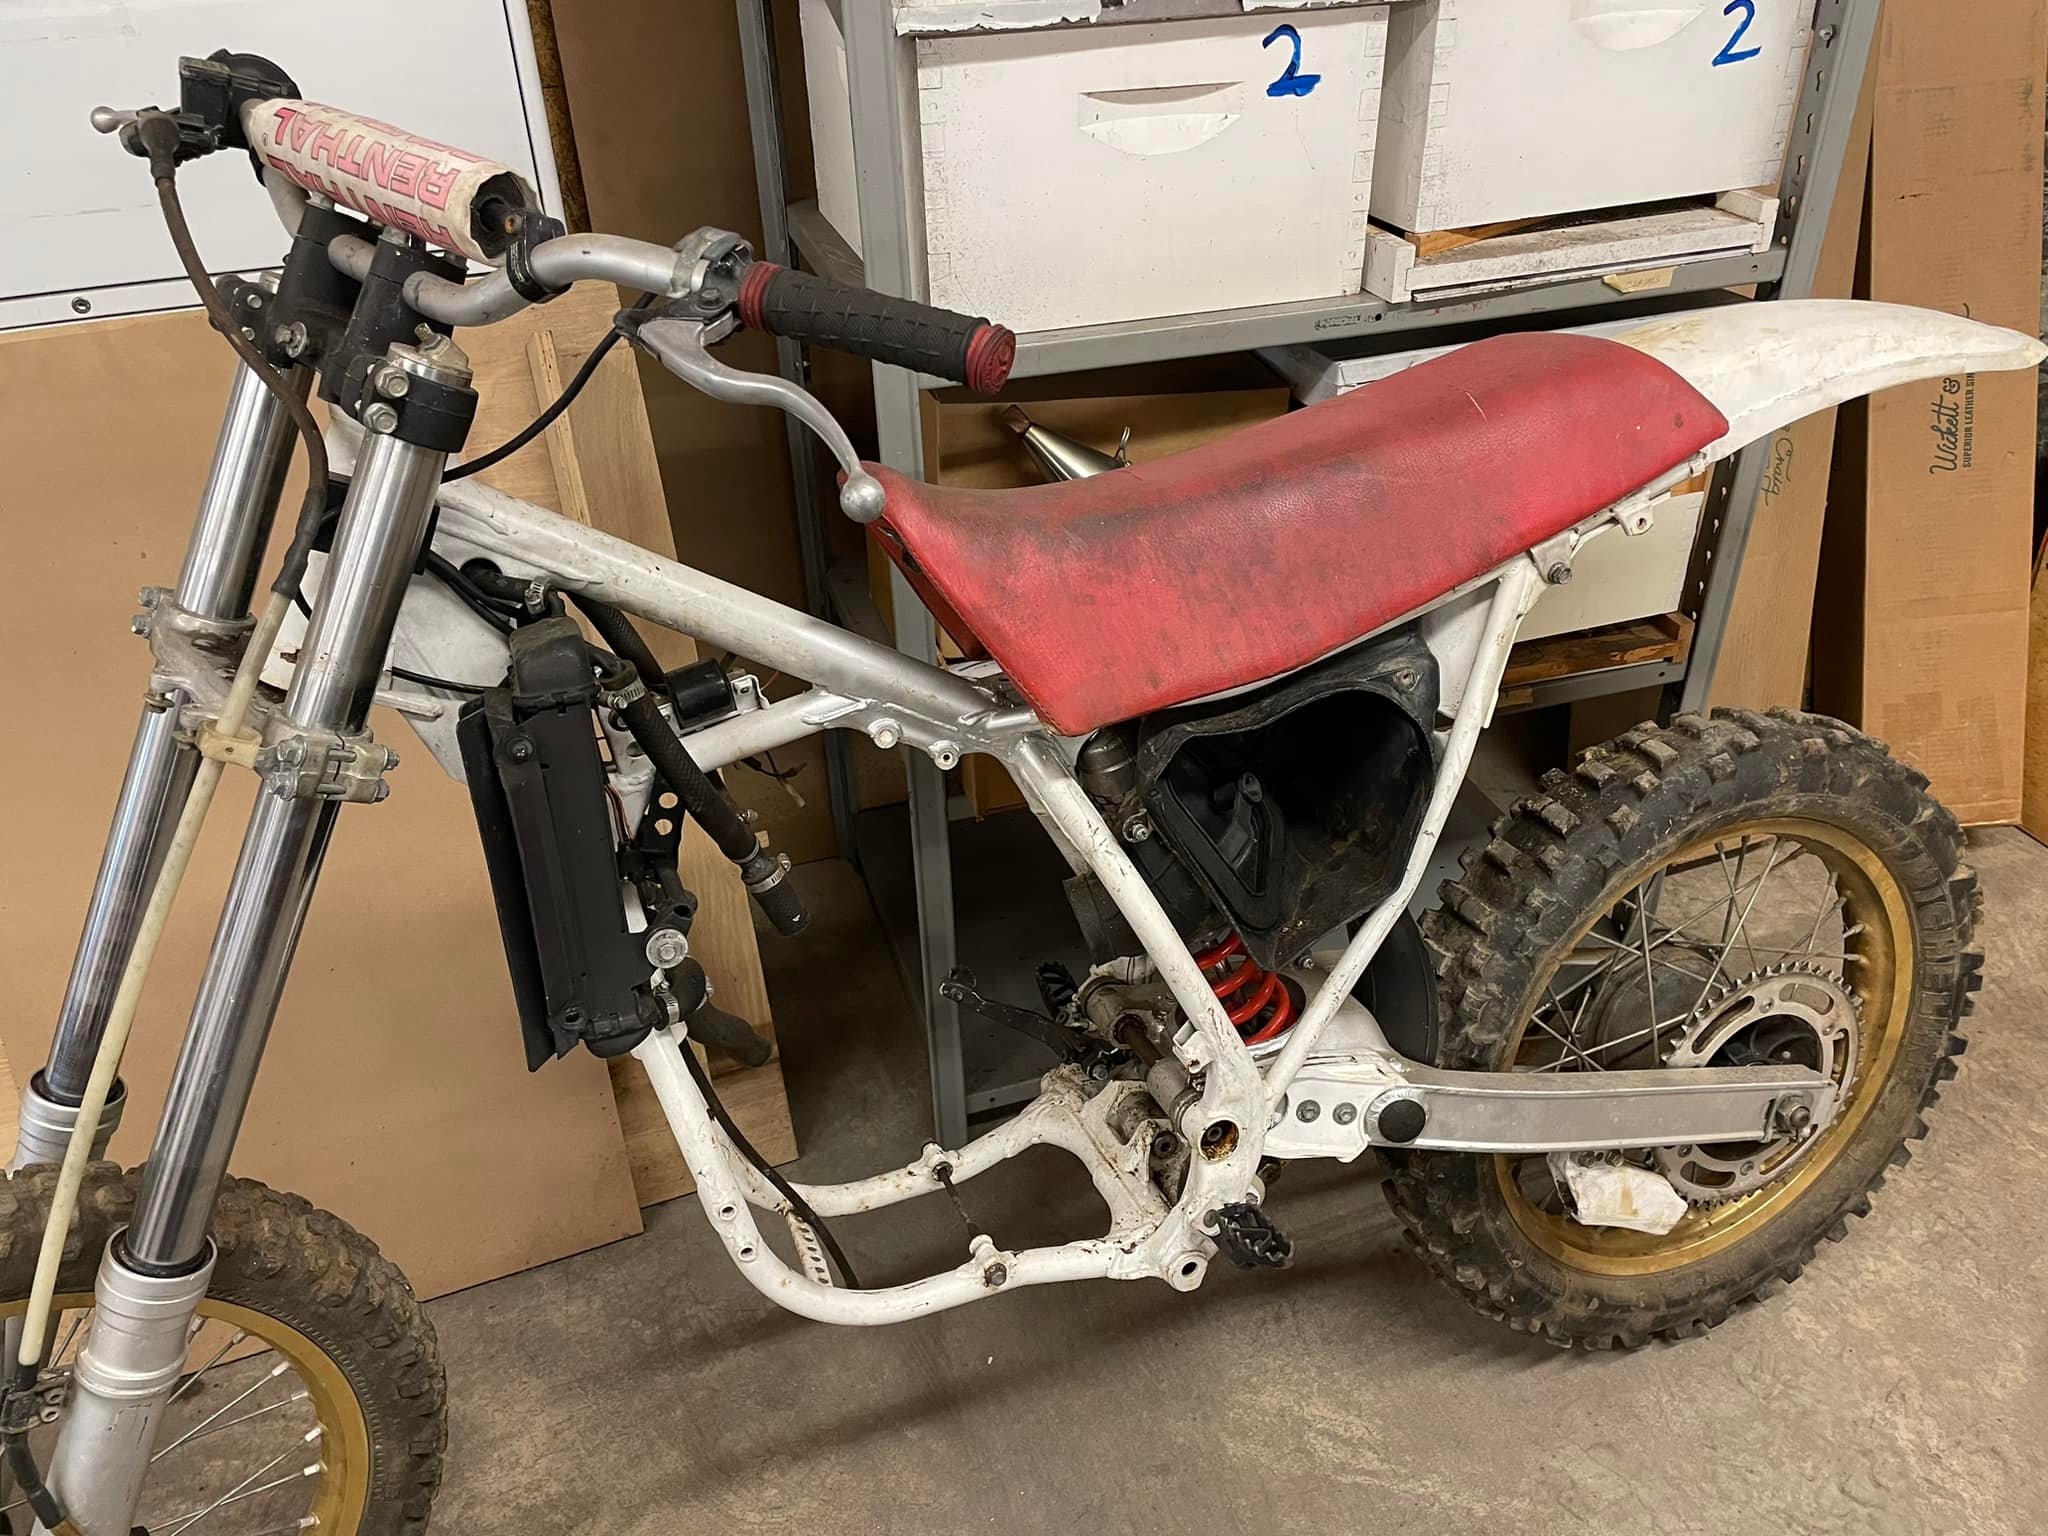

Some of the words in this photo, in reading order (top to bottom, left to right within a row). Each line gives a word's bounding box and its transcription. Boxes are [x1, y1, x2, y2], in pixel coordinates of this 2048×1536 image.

[1262, 24, 1322, 97] 2
[1712, 0, 1761, 67] 2
[273, 106, 461, 210] RENTHAL
[1942, 377, 1960, 394] &
[1964, 389, 1974, 424] LEATHER
[1929, 394, 1960, 474] Wickett
[1963, 426, 1973, 467] SUPERIOR
